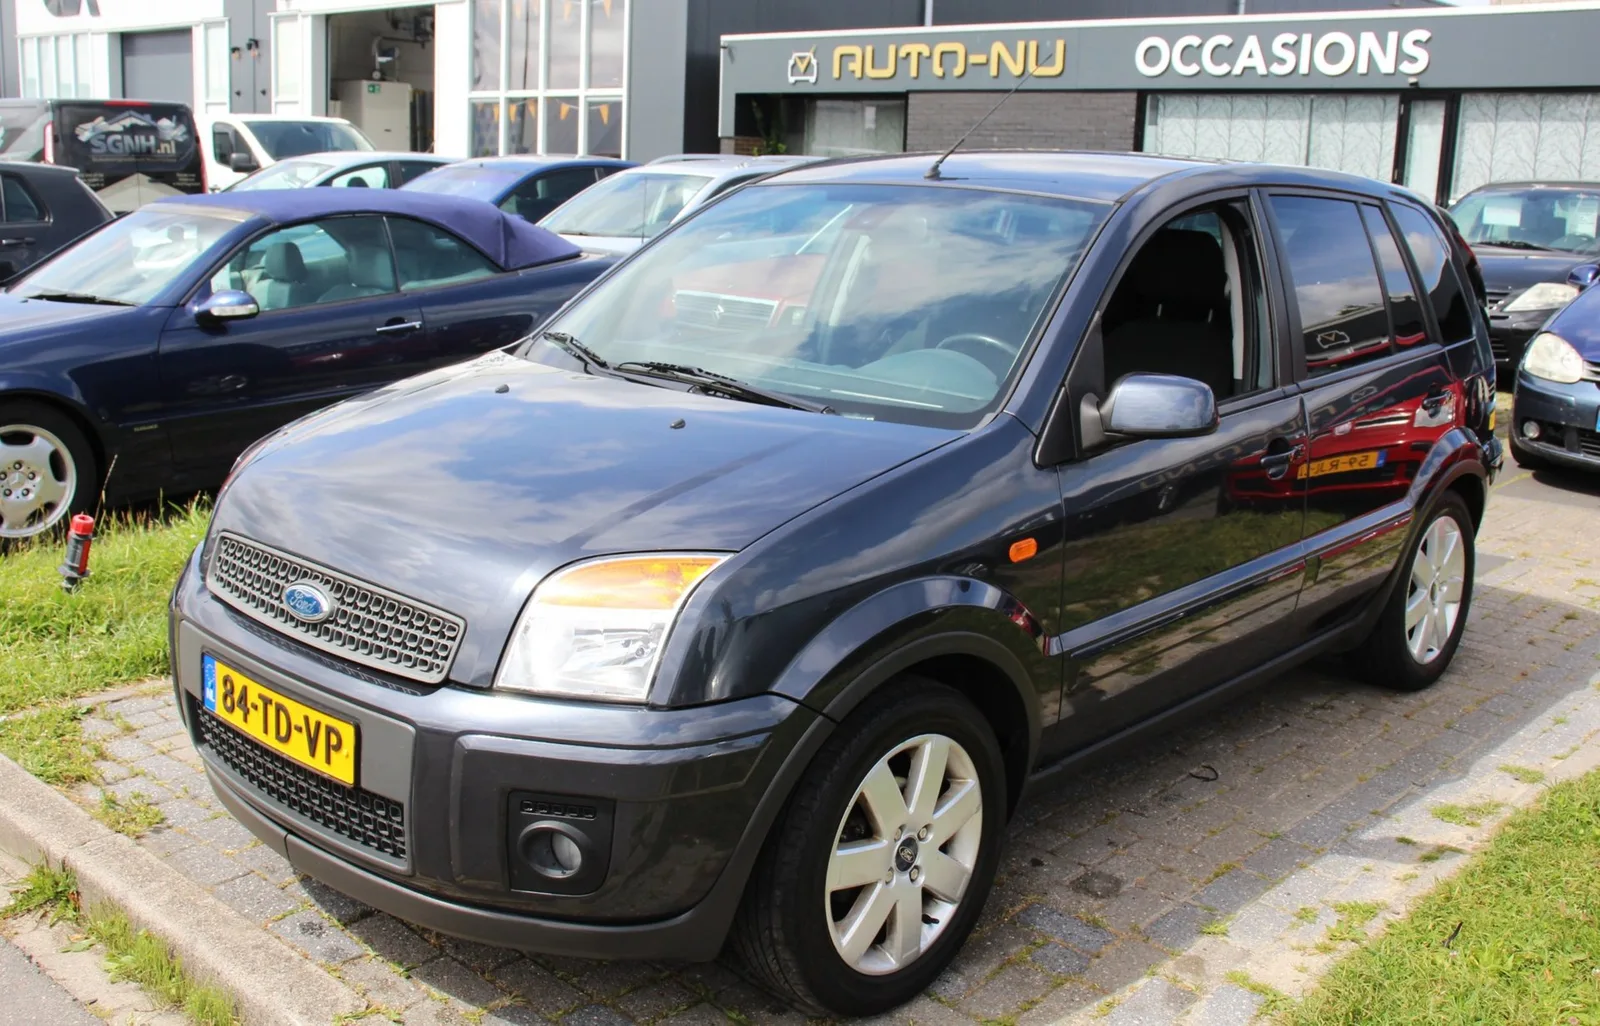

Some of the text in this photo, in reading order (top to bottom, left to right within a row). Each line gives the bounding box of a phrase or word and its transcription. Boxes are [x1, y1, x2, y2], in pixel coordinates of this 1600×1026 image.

[832, 38, 1066, 79] AUTO-NU
[1134, 28, 1432, 77] OCCASIONS
[91, 134, 177, 154] SGNH.nl
[289, 589, 317, 614] Ford
[222, 674, 343, 765] 84-TD-VP
